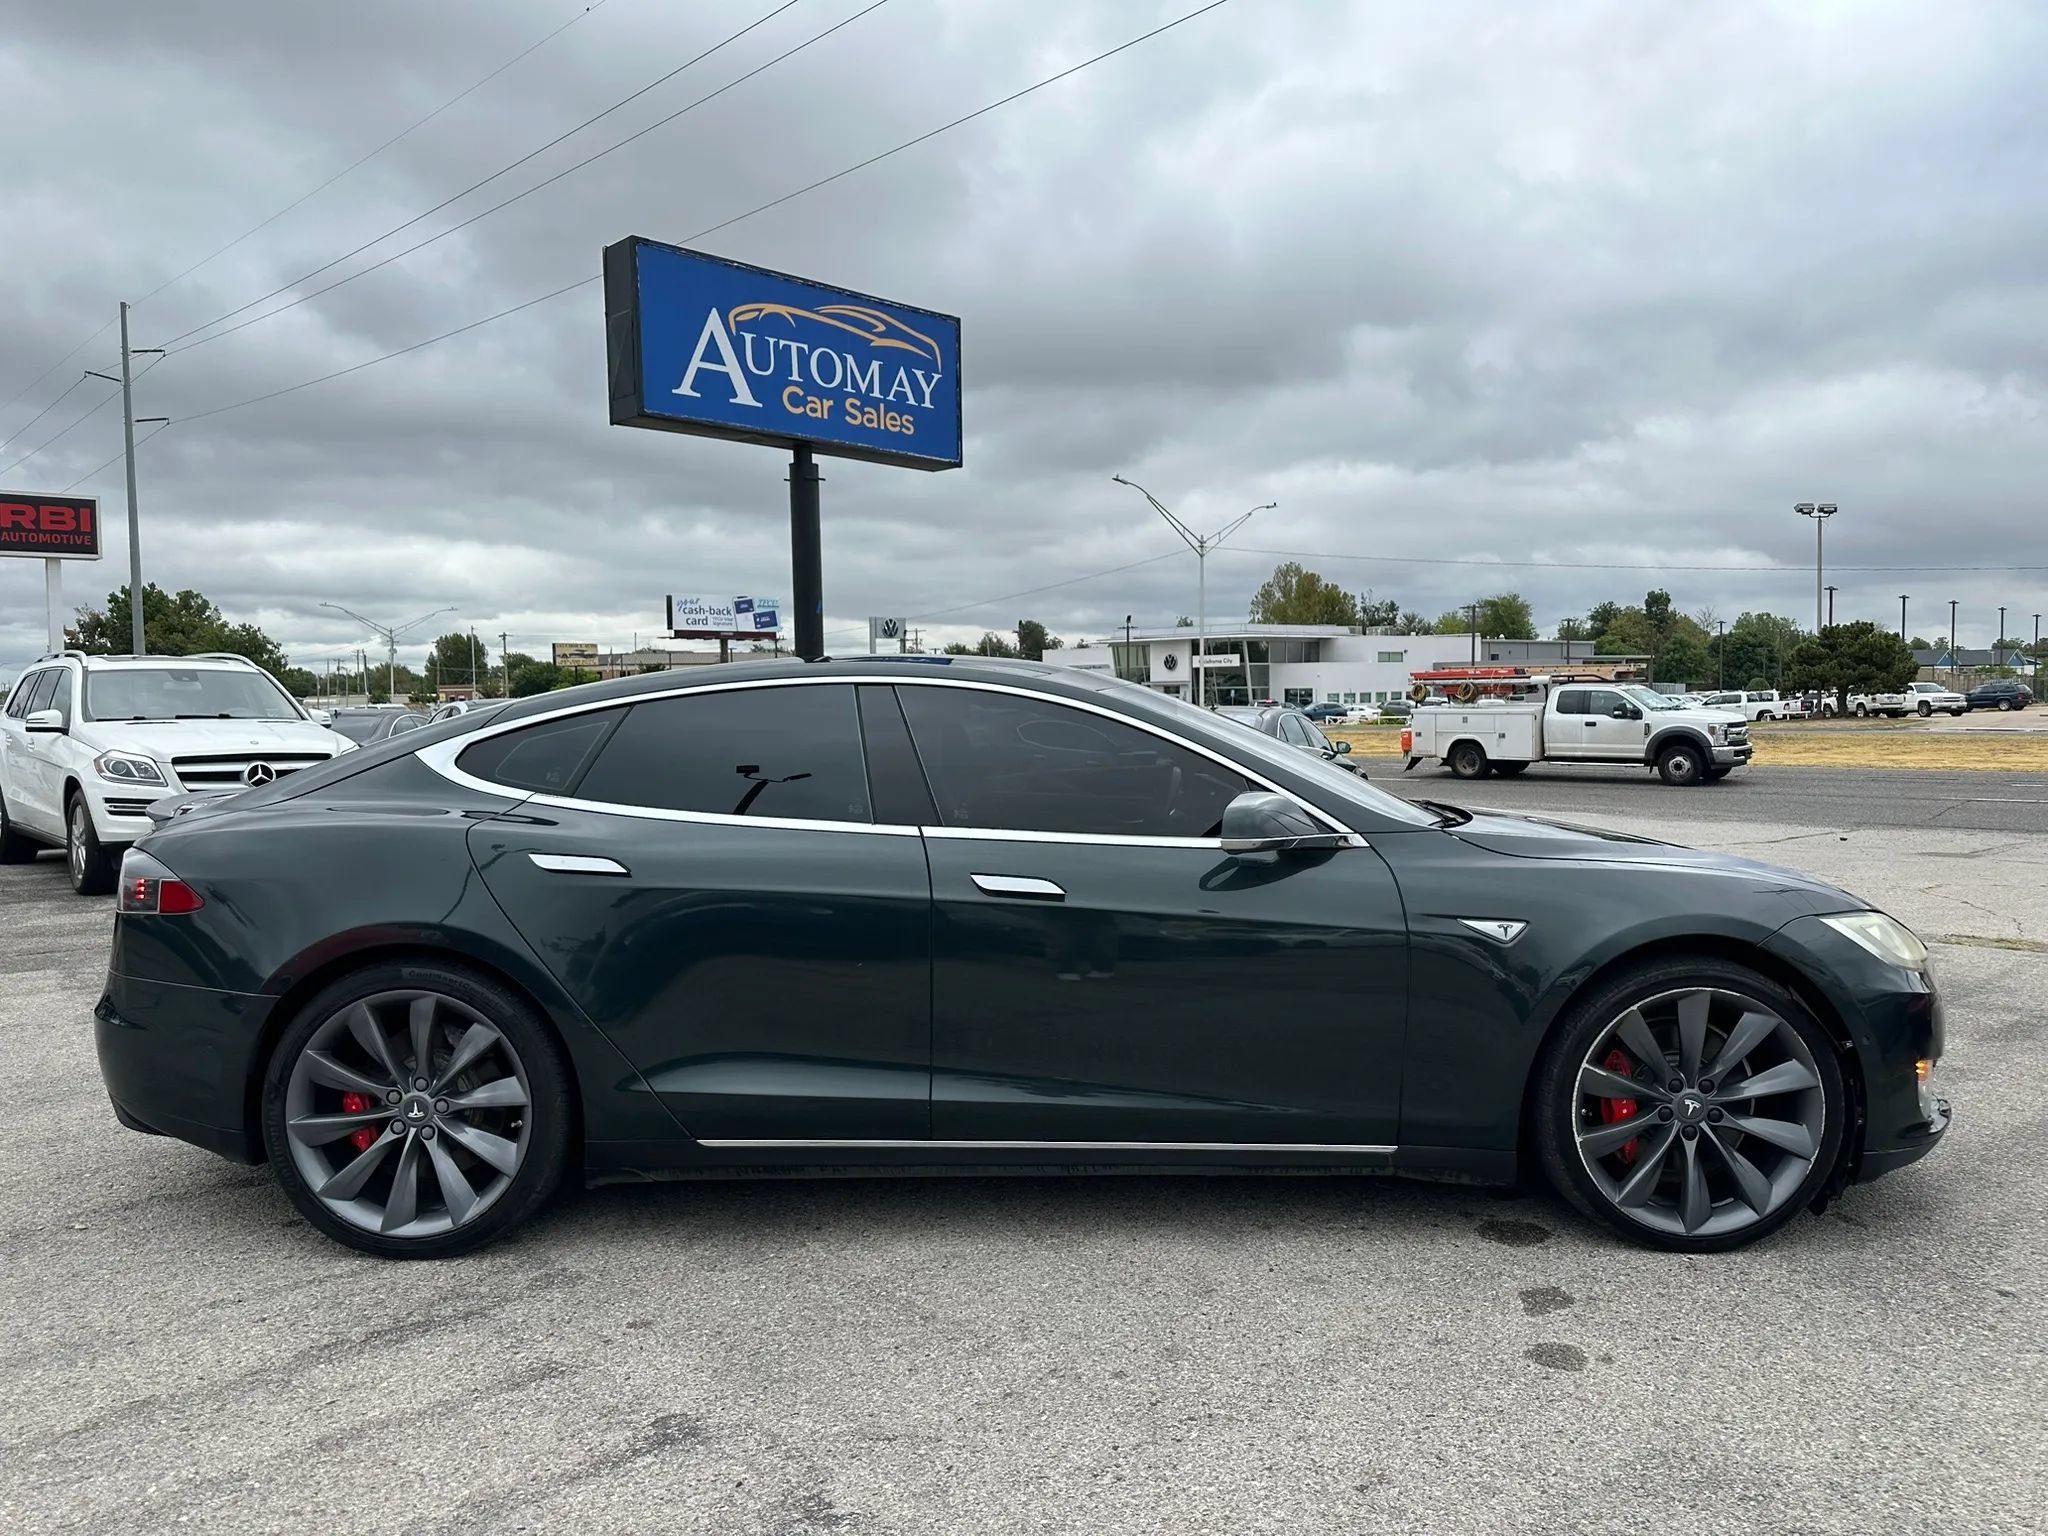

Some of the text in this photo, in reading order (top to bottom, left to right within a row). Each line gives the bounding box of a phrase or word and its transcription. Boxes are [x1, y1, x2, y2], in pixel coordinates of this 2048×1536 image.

[672, 307, 943, 409] AUTOMAY
[782, 385, 915, 436] Car Sales
[0, 502, 91, 532] RBI
[1, 531, 92, 545] AUTOMOTIVE
[676, 598, 700, 611] your
[682, 604, 733, 616] cash-back
[685, 616, 709, 626] card
